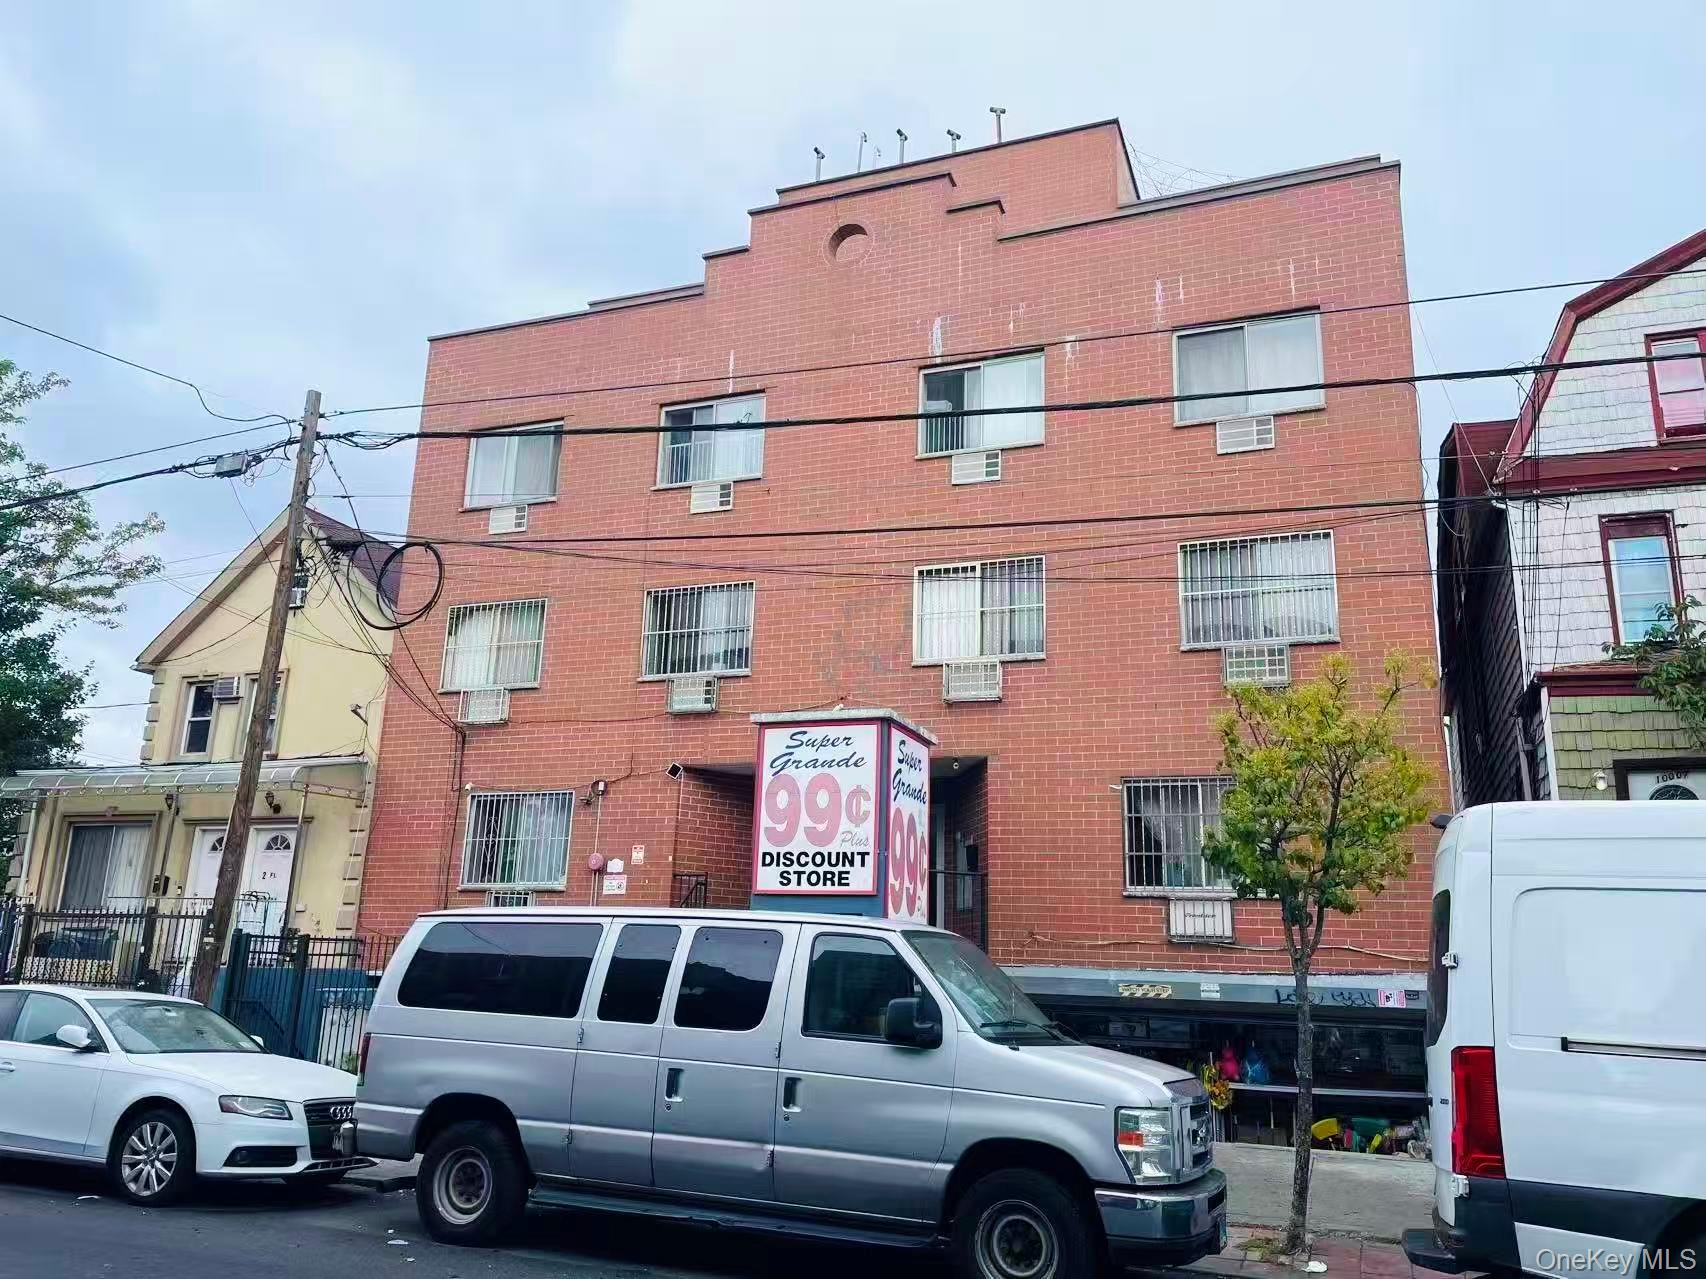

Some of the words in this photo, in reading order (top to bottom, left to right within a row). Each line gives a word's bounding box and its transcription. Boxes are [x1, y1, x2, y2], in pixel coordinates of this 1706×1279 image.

[785, 730, 854, 752] Super
[769, 751, 868, 777] Grande
[897, 739, 922, 773] Super
[892, 768, 928, 805] Grande
[840, 830, 871, 848] Plus
[761, 851, 870, 868] DISCOUNT
[261, 871, 267, 880] 2
[778, 870, 851, 887] STORE
